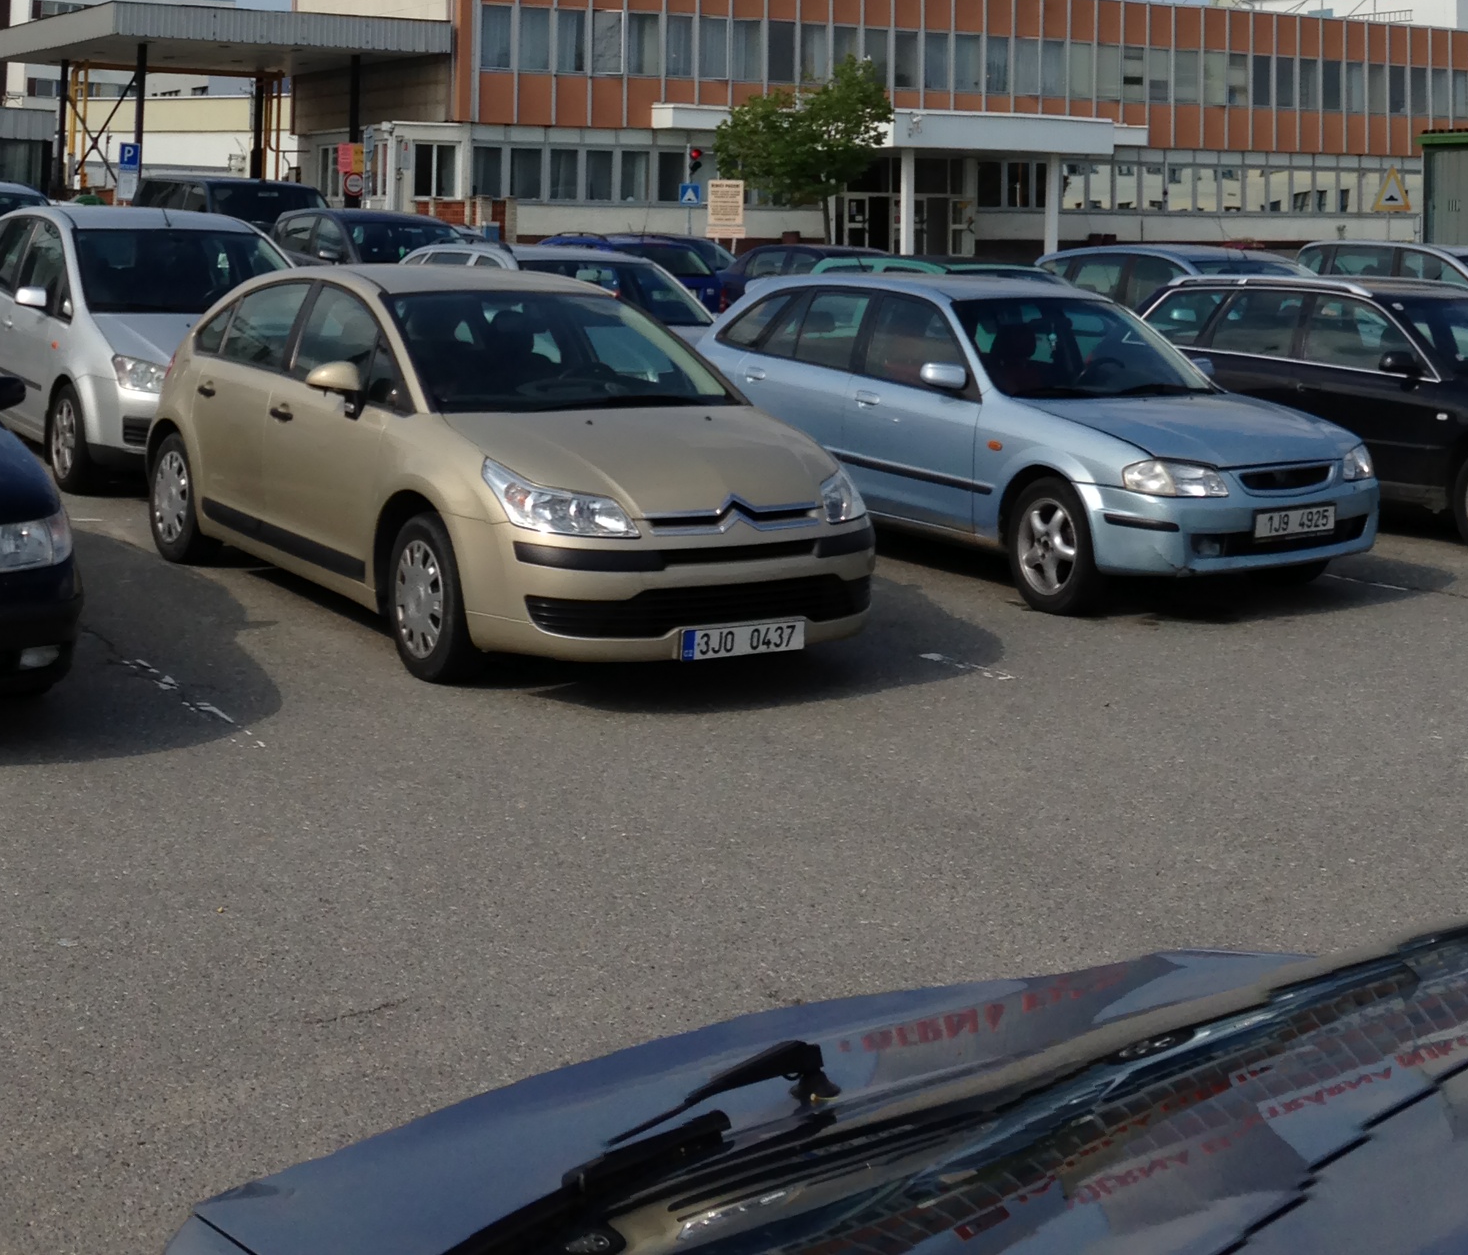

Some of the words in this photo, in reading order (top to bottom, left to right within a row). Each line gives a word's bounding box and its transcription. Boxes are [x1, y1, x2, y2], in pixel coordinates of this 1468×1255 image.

[124, 147, 134, 162] P
[1268, 514, 1290, 533] 1J9
[1299, 509, 1329, 529] 4925
[750, 625, 796, 650] 0437
